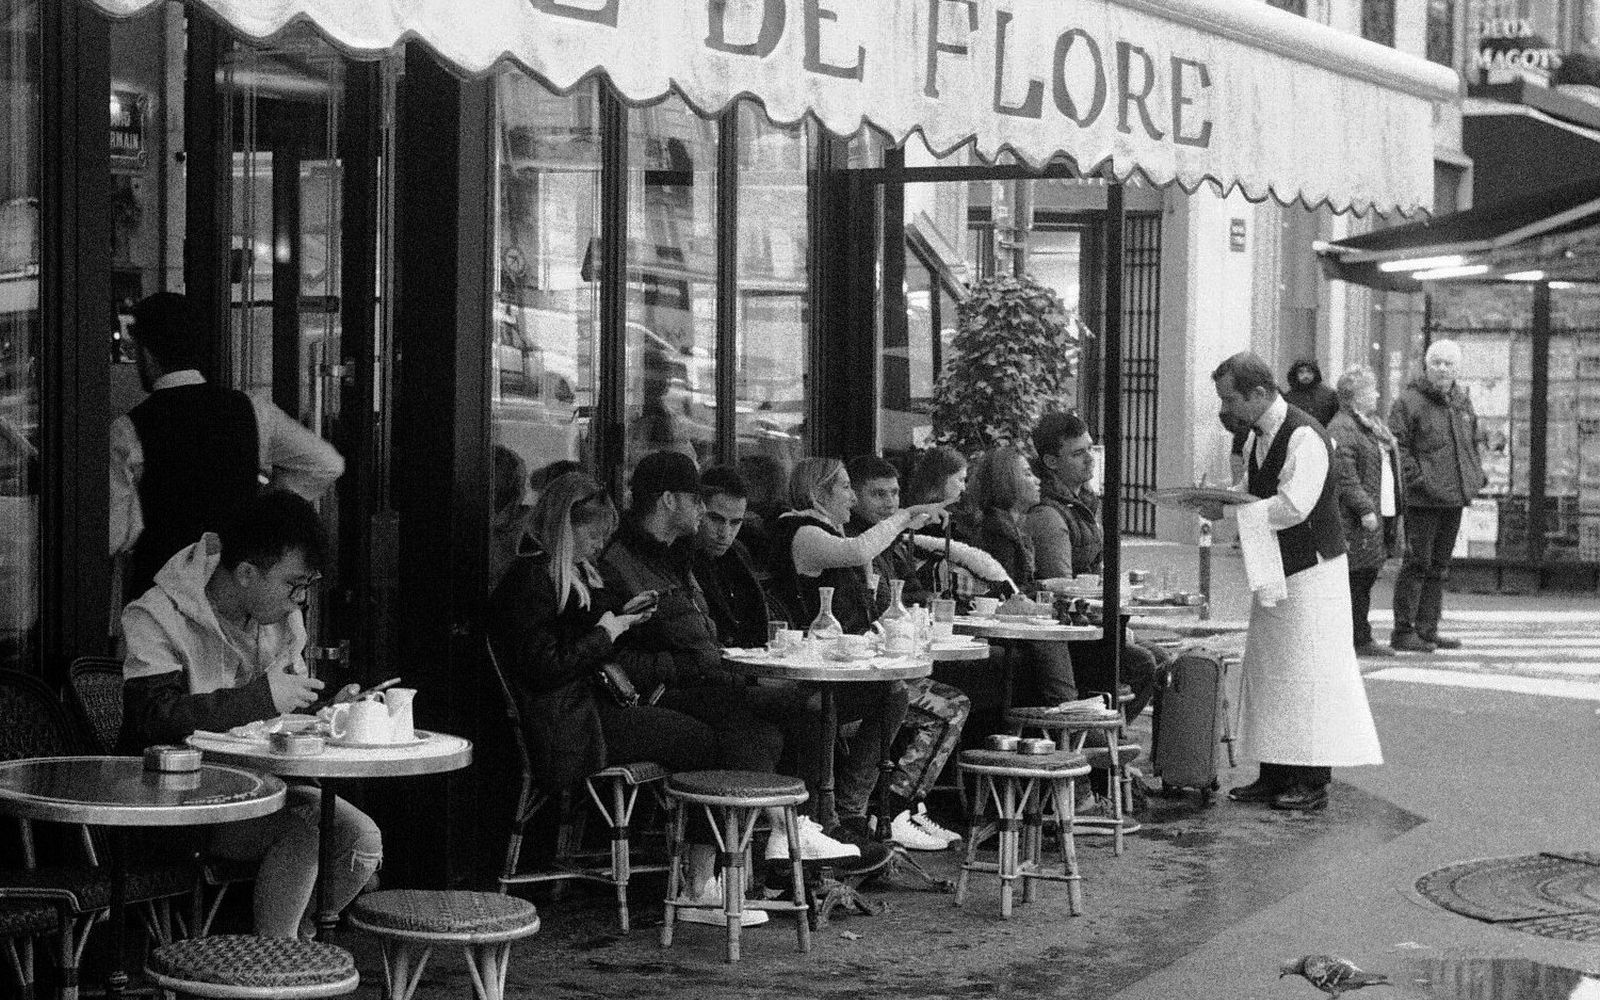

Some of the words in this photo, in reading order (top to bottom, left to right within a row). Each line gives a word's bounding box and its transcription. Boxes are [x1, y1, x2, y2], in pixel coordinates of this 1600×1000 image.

[1475, 19, 1534, 38] DEUX
[1471, 48, 1562, 71] MAGOTS
[924, 0, 1213, 148] FLORE
